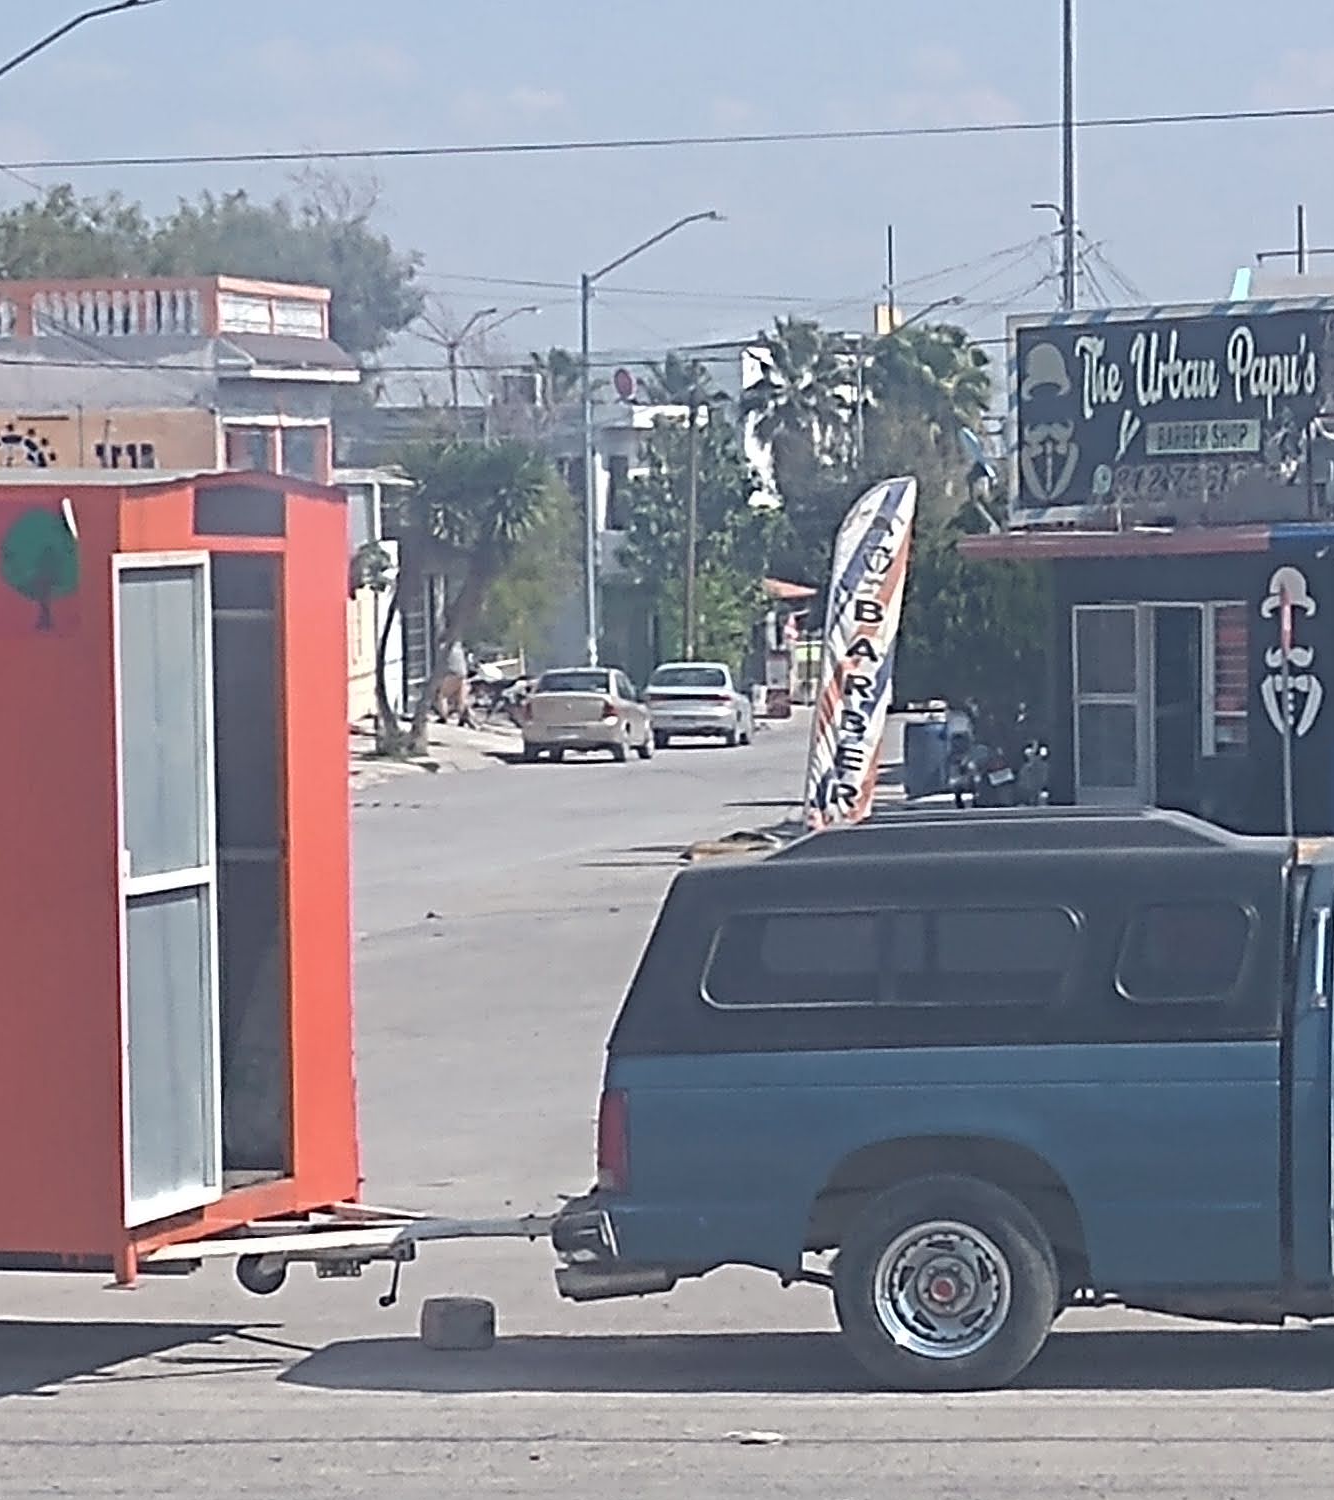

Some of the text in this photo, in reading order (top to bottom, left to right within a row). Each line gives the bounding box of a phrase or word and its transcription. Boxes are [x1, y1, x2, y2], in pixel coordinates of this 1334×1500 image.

[1075, 326, 1316, 420] The Urban Papu's
[831, 599, 884, 809] BARBER
